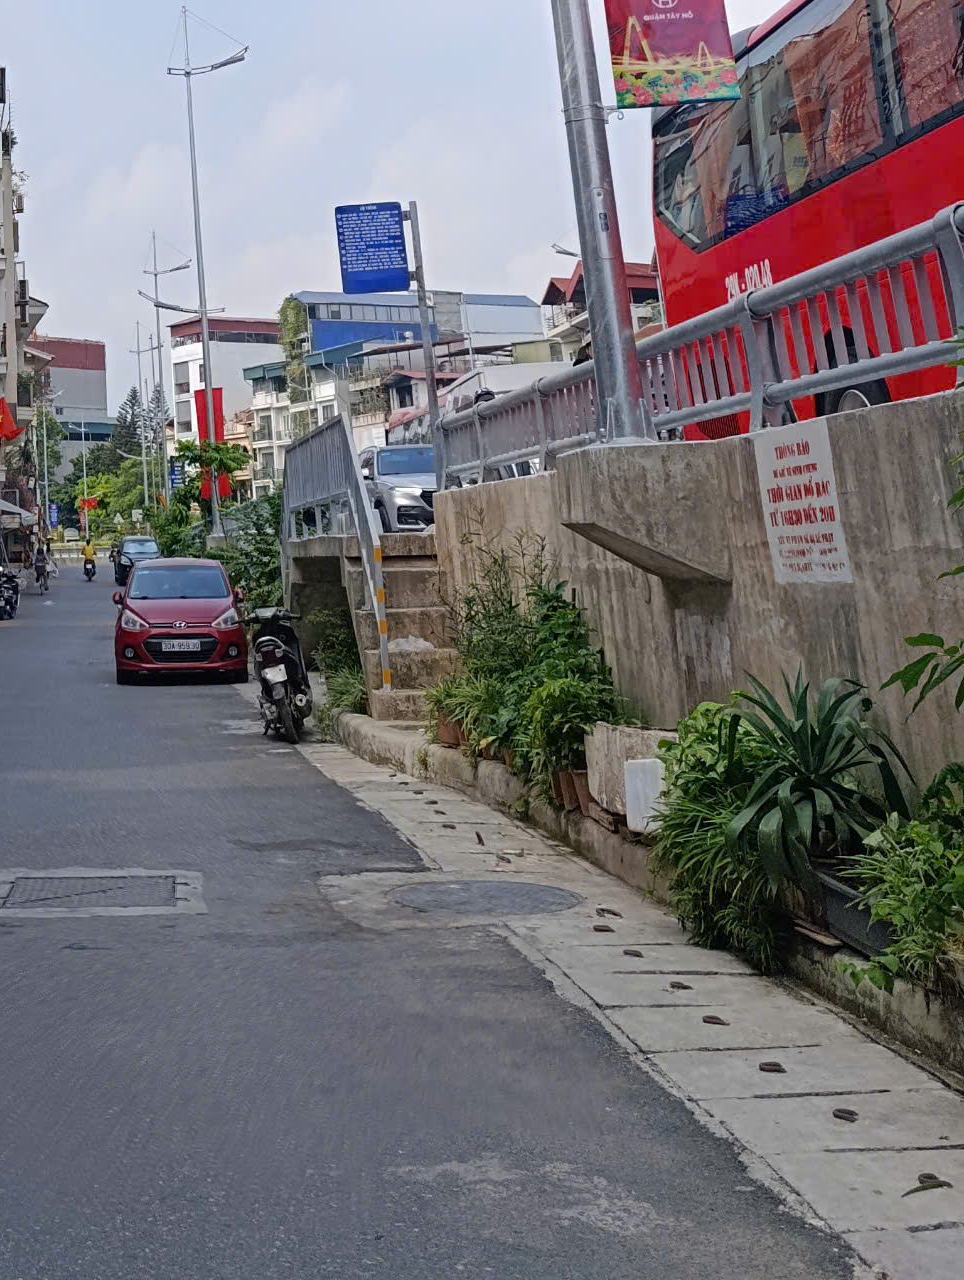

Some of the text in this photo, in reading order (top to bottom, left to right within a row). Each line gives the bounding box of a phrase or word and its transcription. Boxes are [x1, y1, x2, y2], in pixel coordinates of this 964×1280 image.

[643, 10, 694, 21] QUẬN TÂY HỒ
[796, 438, 810, 456] BÁO
[767, 483, 784, 504] THỜI
[785, 483, 803, 501] GIAN
[815, 479, 831, 498] RÁC
[803, 504, 818, 524] ĐẾN
[819, 505, 835, 522] 20H
